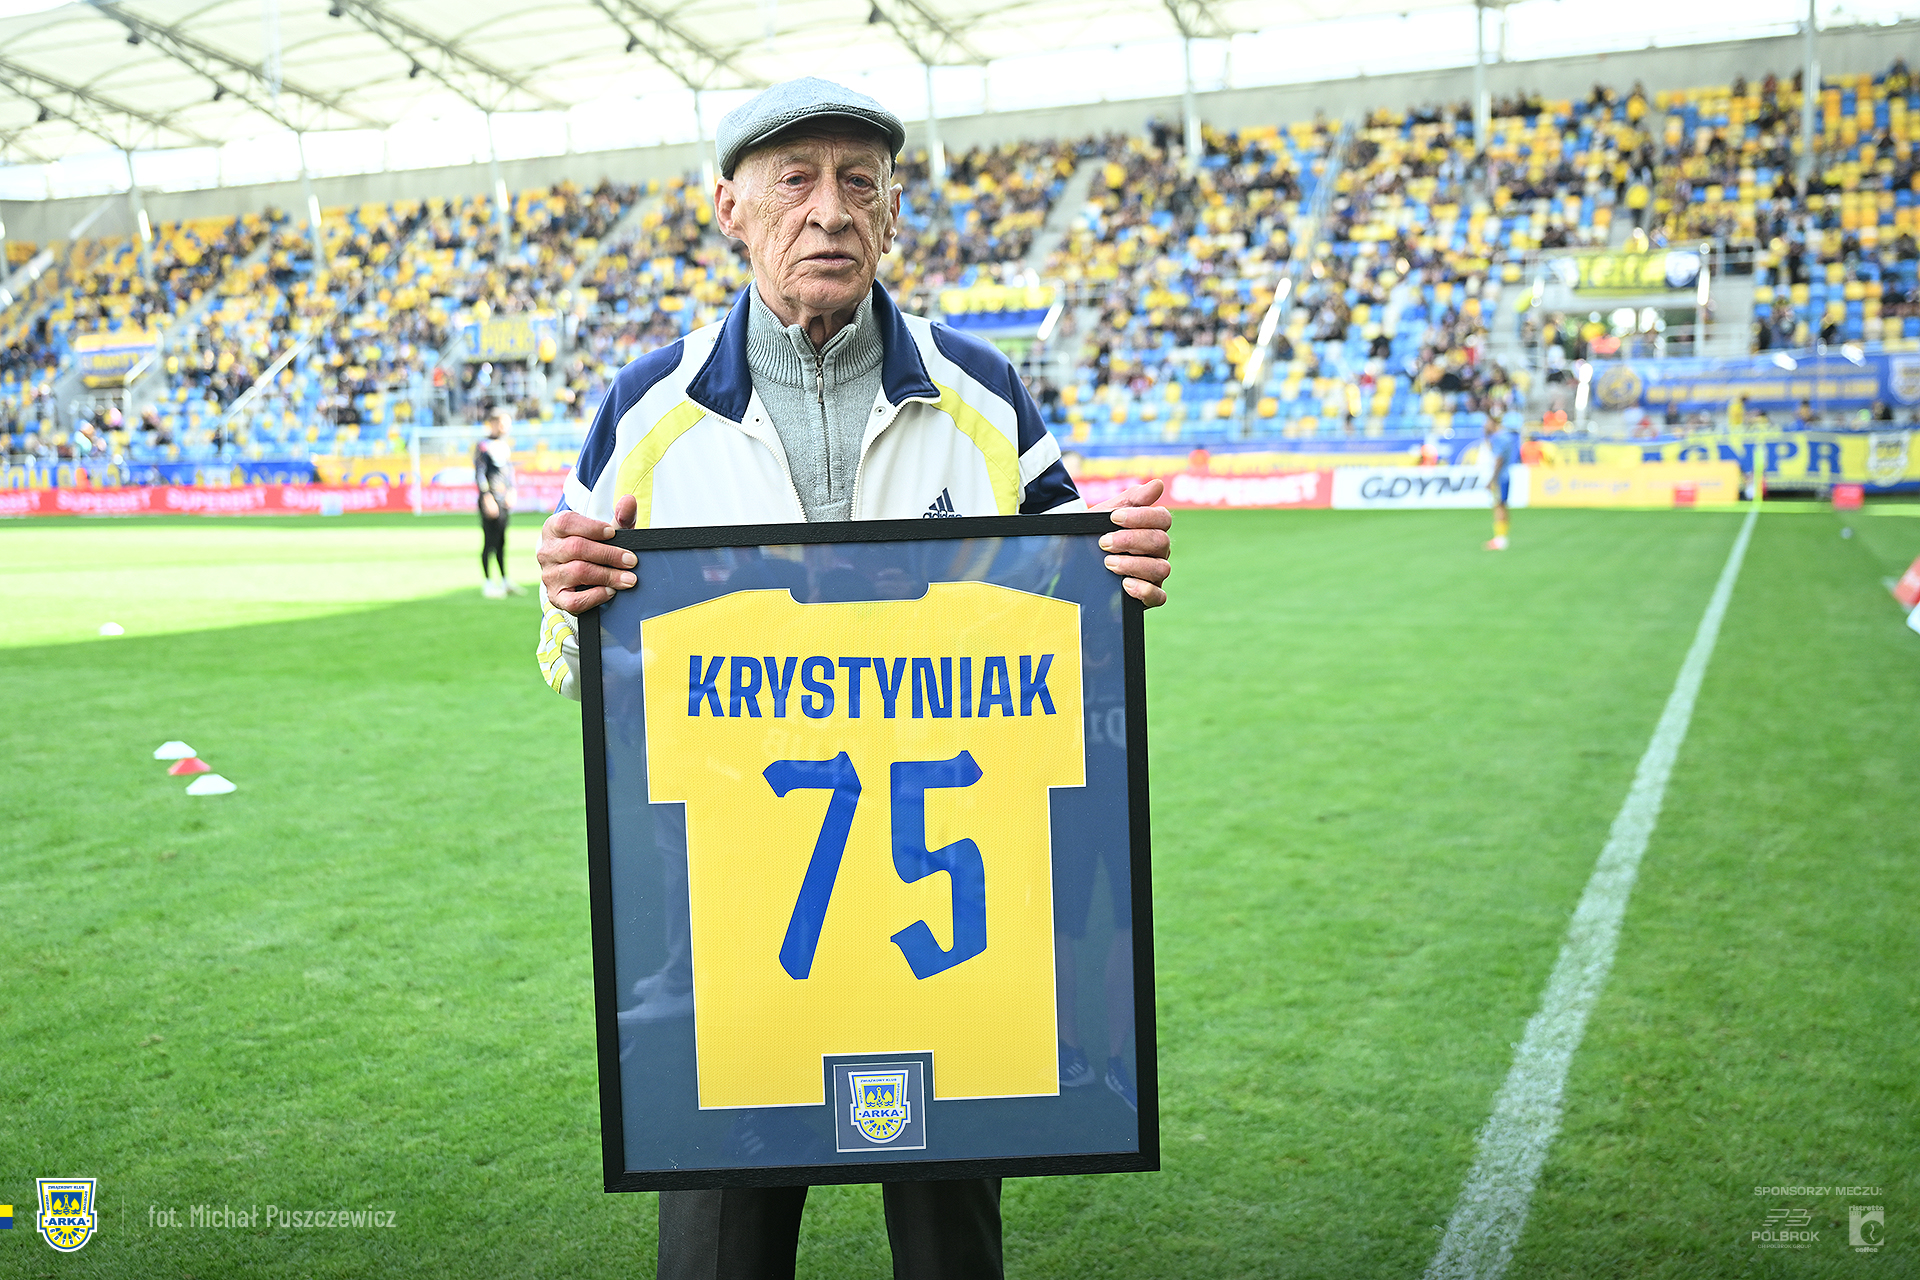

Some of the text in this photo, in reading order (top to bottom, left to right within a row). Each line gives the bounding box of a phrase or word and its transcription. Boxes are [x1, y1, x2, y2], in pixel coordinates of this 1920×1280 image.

[1361, 475, 1480, 500] GDYNI
[687, 653, 1057, 719] KRYSTYNIAK
[762, 750, 987, 980] 75
[862, 1109, 899, 1117] ARKA
